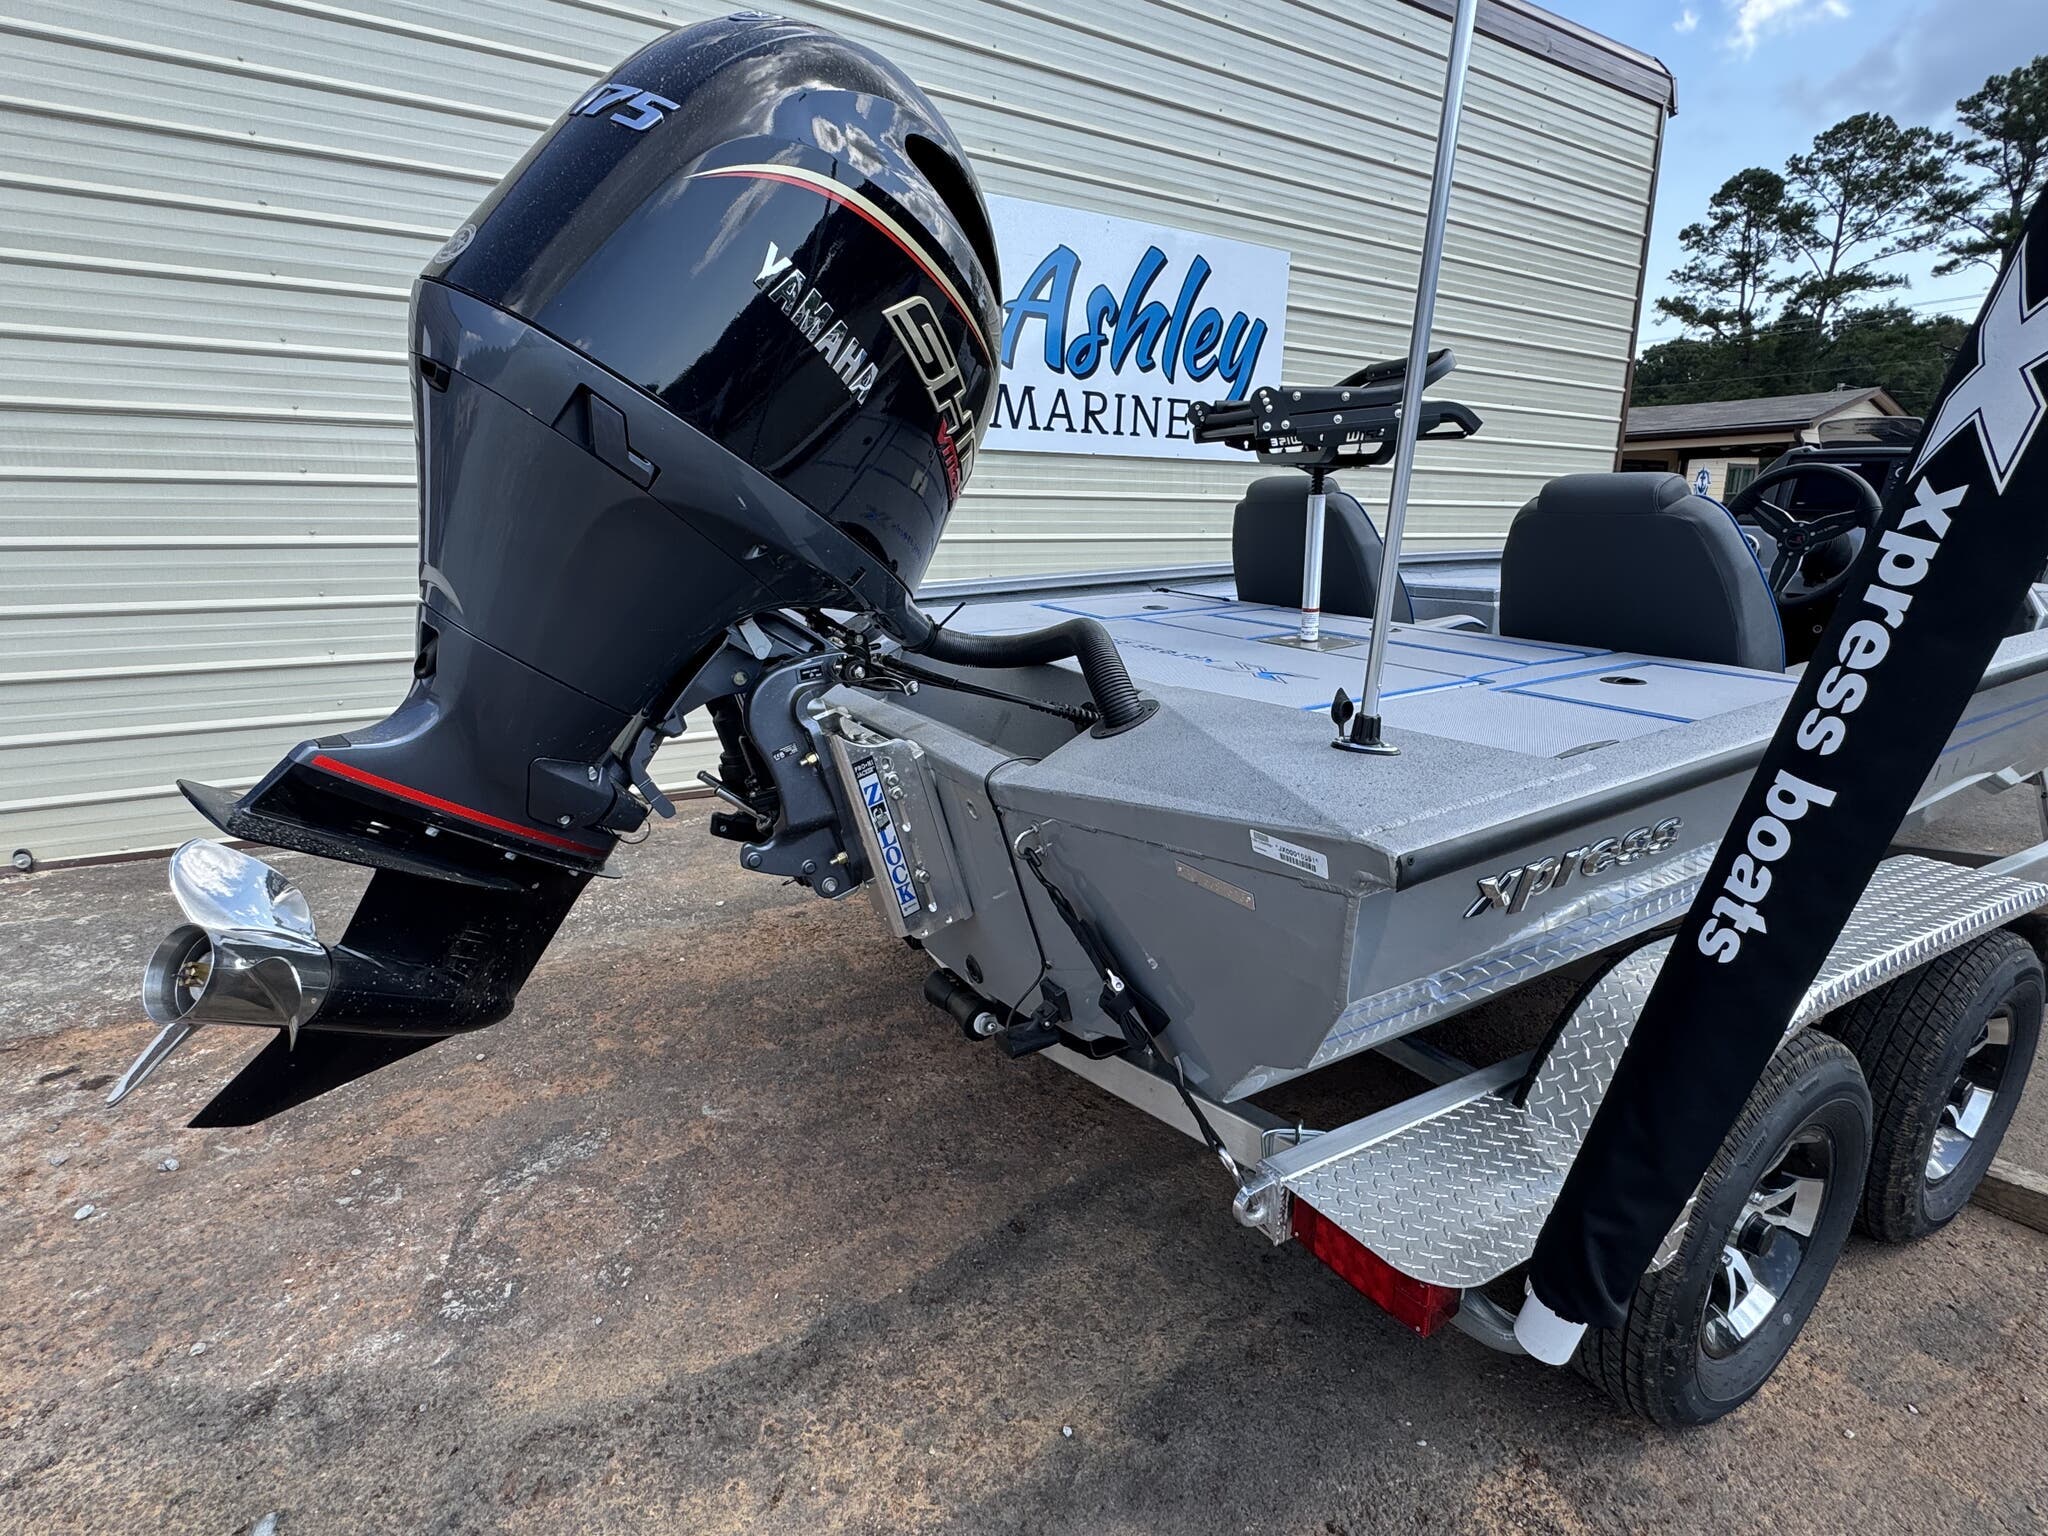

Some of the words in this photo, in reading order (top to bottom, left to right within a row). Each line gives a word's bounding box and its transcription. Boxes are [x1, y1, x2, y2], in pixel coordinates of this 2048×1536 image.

[569, 82, 681, 131] 175
[753, 240, 879, 406] YAMAHA
[1001, 243, 1268, 401] Ashley
[989, 383, 1193, 440] MARINE
[1796, 475, 1969, 757] xpress
[863, 782, 885, 807] Z
[878, 829, 916, 906] LOCK
[1463, 817, 1685, 919] xpress
[1697, 768, 1838, 964] boats
